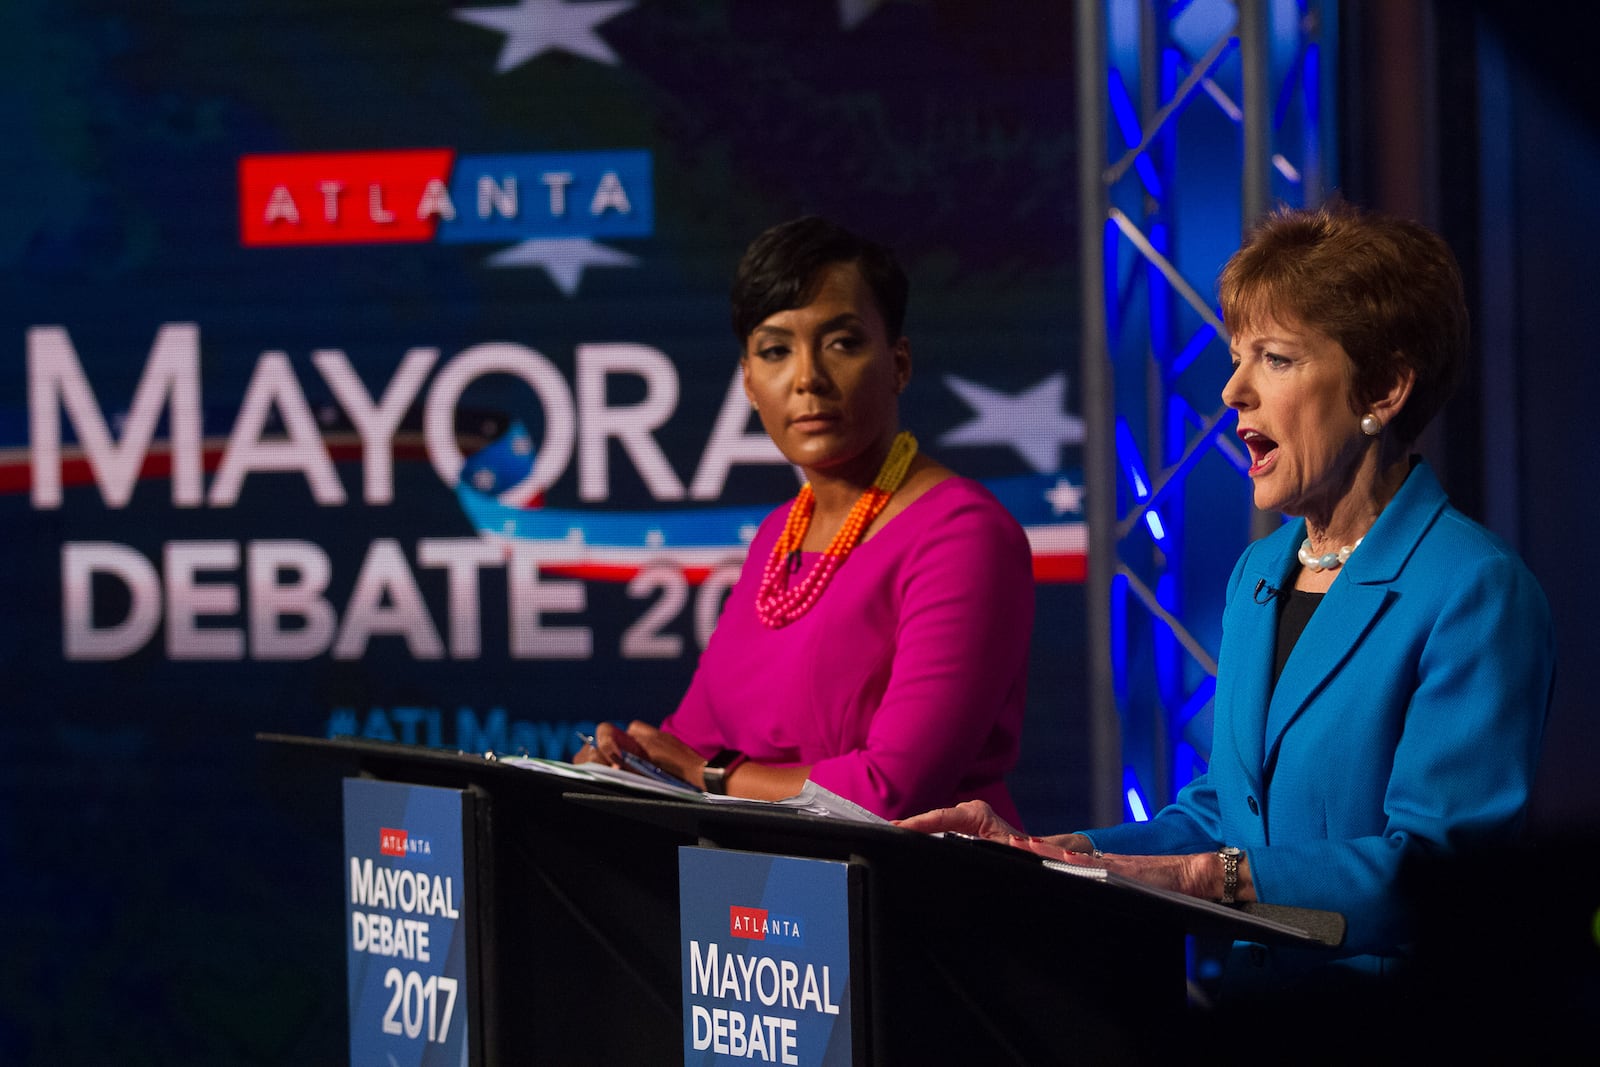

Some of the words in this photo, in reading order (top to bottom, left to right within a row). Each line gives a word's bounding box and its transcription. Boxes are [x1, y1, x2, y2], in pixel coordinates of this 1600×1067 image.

[264, 171, 632, 225] ATLANTA
[26, 322, 807, 509] MAYORA
[61, 538, 593, 662] DEBATE
[619, 557, 742, 659] 20
[381, 835, 432, 855] ATLANTA
[350, 856, 460, 919] MAYORAL
[352, 910, 431, 963] DEBATE
[733, 915, 801, 938] ATLANTA
[382, 967, 458, 1044] 2017
[689, 940, 840, 1015] MAYORAL
[692, 1004, 799, 1066] DEBATE
